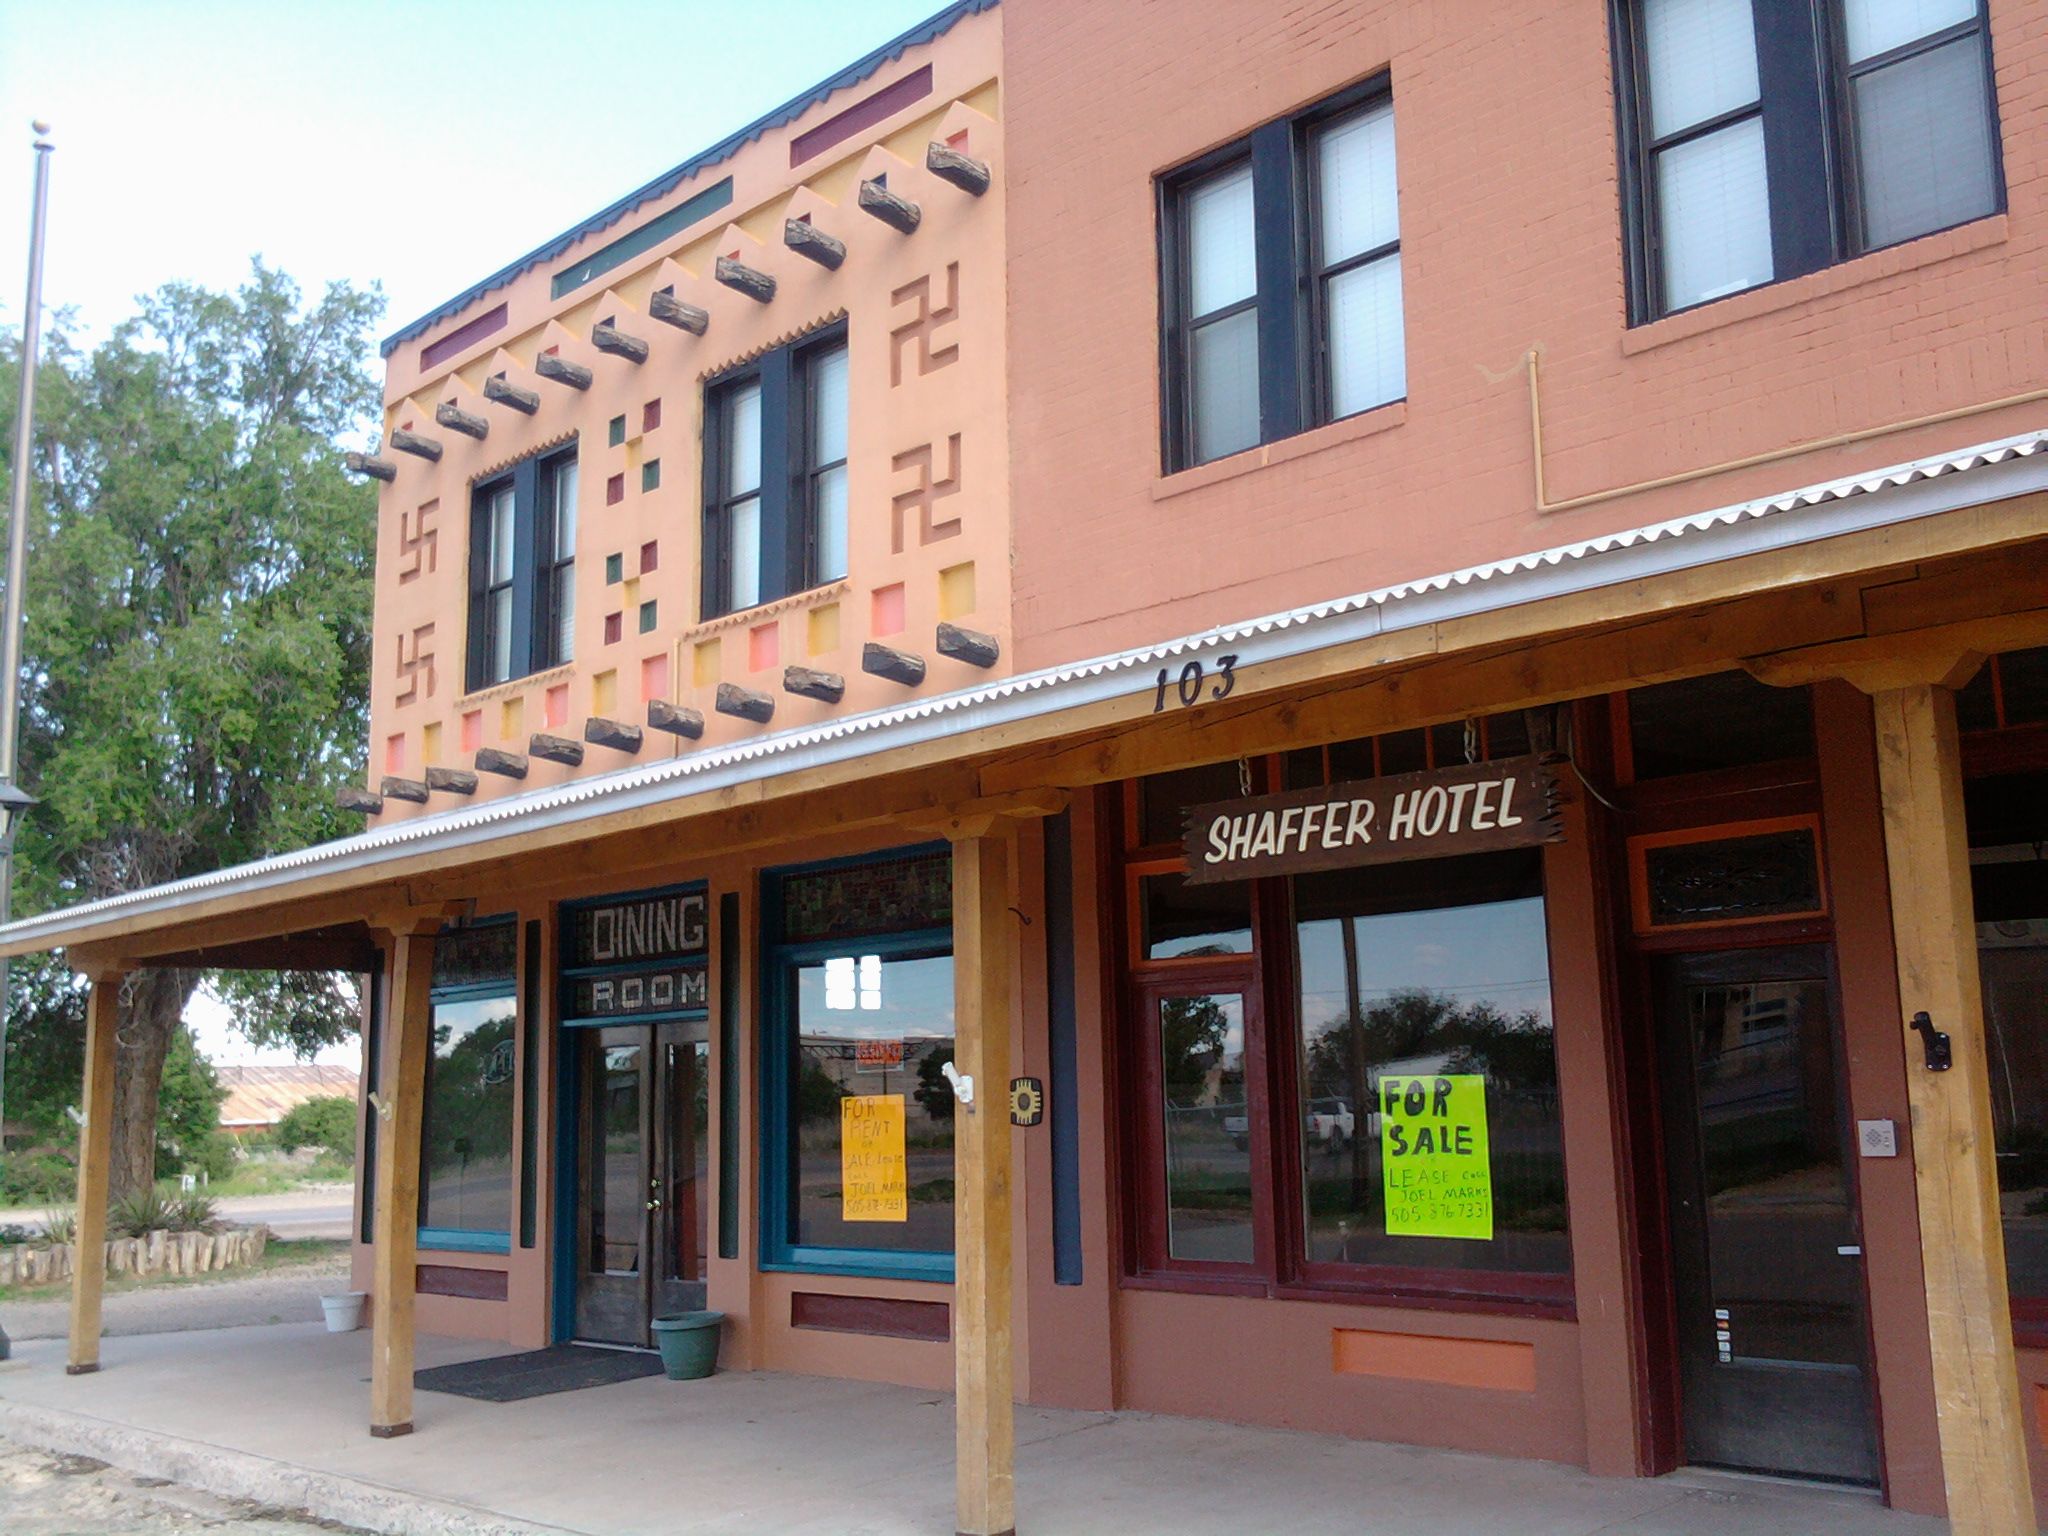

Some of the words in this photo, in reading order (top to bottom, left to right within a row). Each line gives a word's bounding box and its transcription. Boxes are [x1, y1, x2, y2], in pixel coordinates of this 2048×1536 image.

[1154, 654, 1239, 713] 103
[1204, 799, 1376, 864] SHAFFER
[1388, 777, 1523, 841] HOTEL
[593, 895, 704, 960] DINING
[592, 971, 706, 1011] ROOM
[843, 1097, 875, 1119] FOR
[1384, 1078, 1452, 1117] FOR
[850, 1119, 890, 1139] RENT
[1389, 1124, 1473, 1157] SALE
[1389, 1168, 1449, 1188] LEASE
[1391, 1205, 1421, 1223] 505
[1459, 1201, 1489, 1218] 7331
[1400, 1188, 1435, 1203] JOEL
